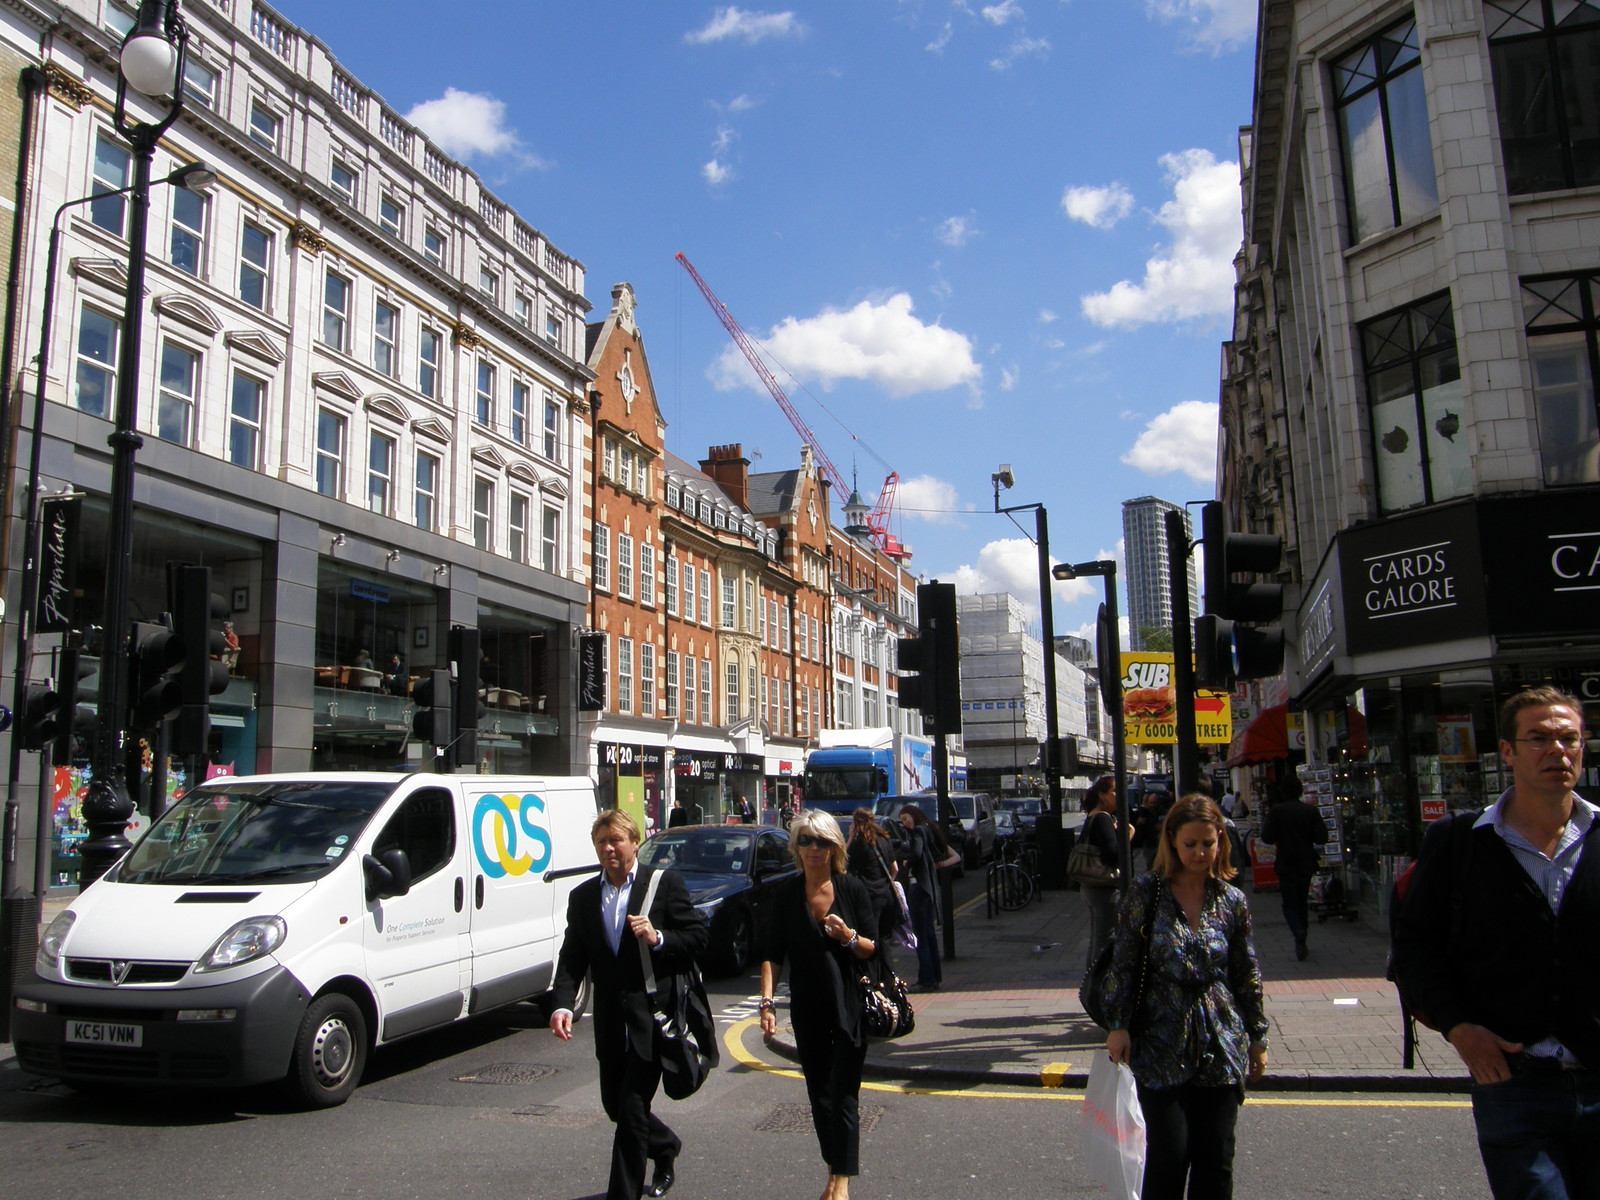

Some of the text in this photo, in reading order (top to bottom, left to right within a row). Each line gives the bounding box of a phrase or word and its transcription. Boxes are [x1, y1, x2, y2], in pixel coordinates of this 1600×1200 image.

[1369, 550, 1447, 584] CARDS
[1365, 577, 1456, 611] GALORE
[1122, 661, 1171, 690] SUB
[1145, 724, 1178, 738] GOOD
[1196, 724, 1228, 738] TREET
[634, 754, 648, 764] optcal
[1423, 806, 1444, 815] SALE
[472, 793, 552, 878] OCS
[387, 917, 445, 933] One Complete Solution
[74, 1023, 135, 1043] KC51 VNM
